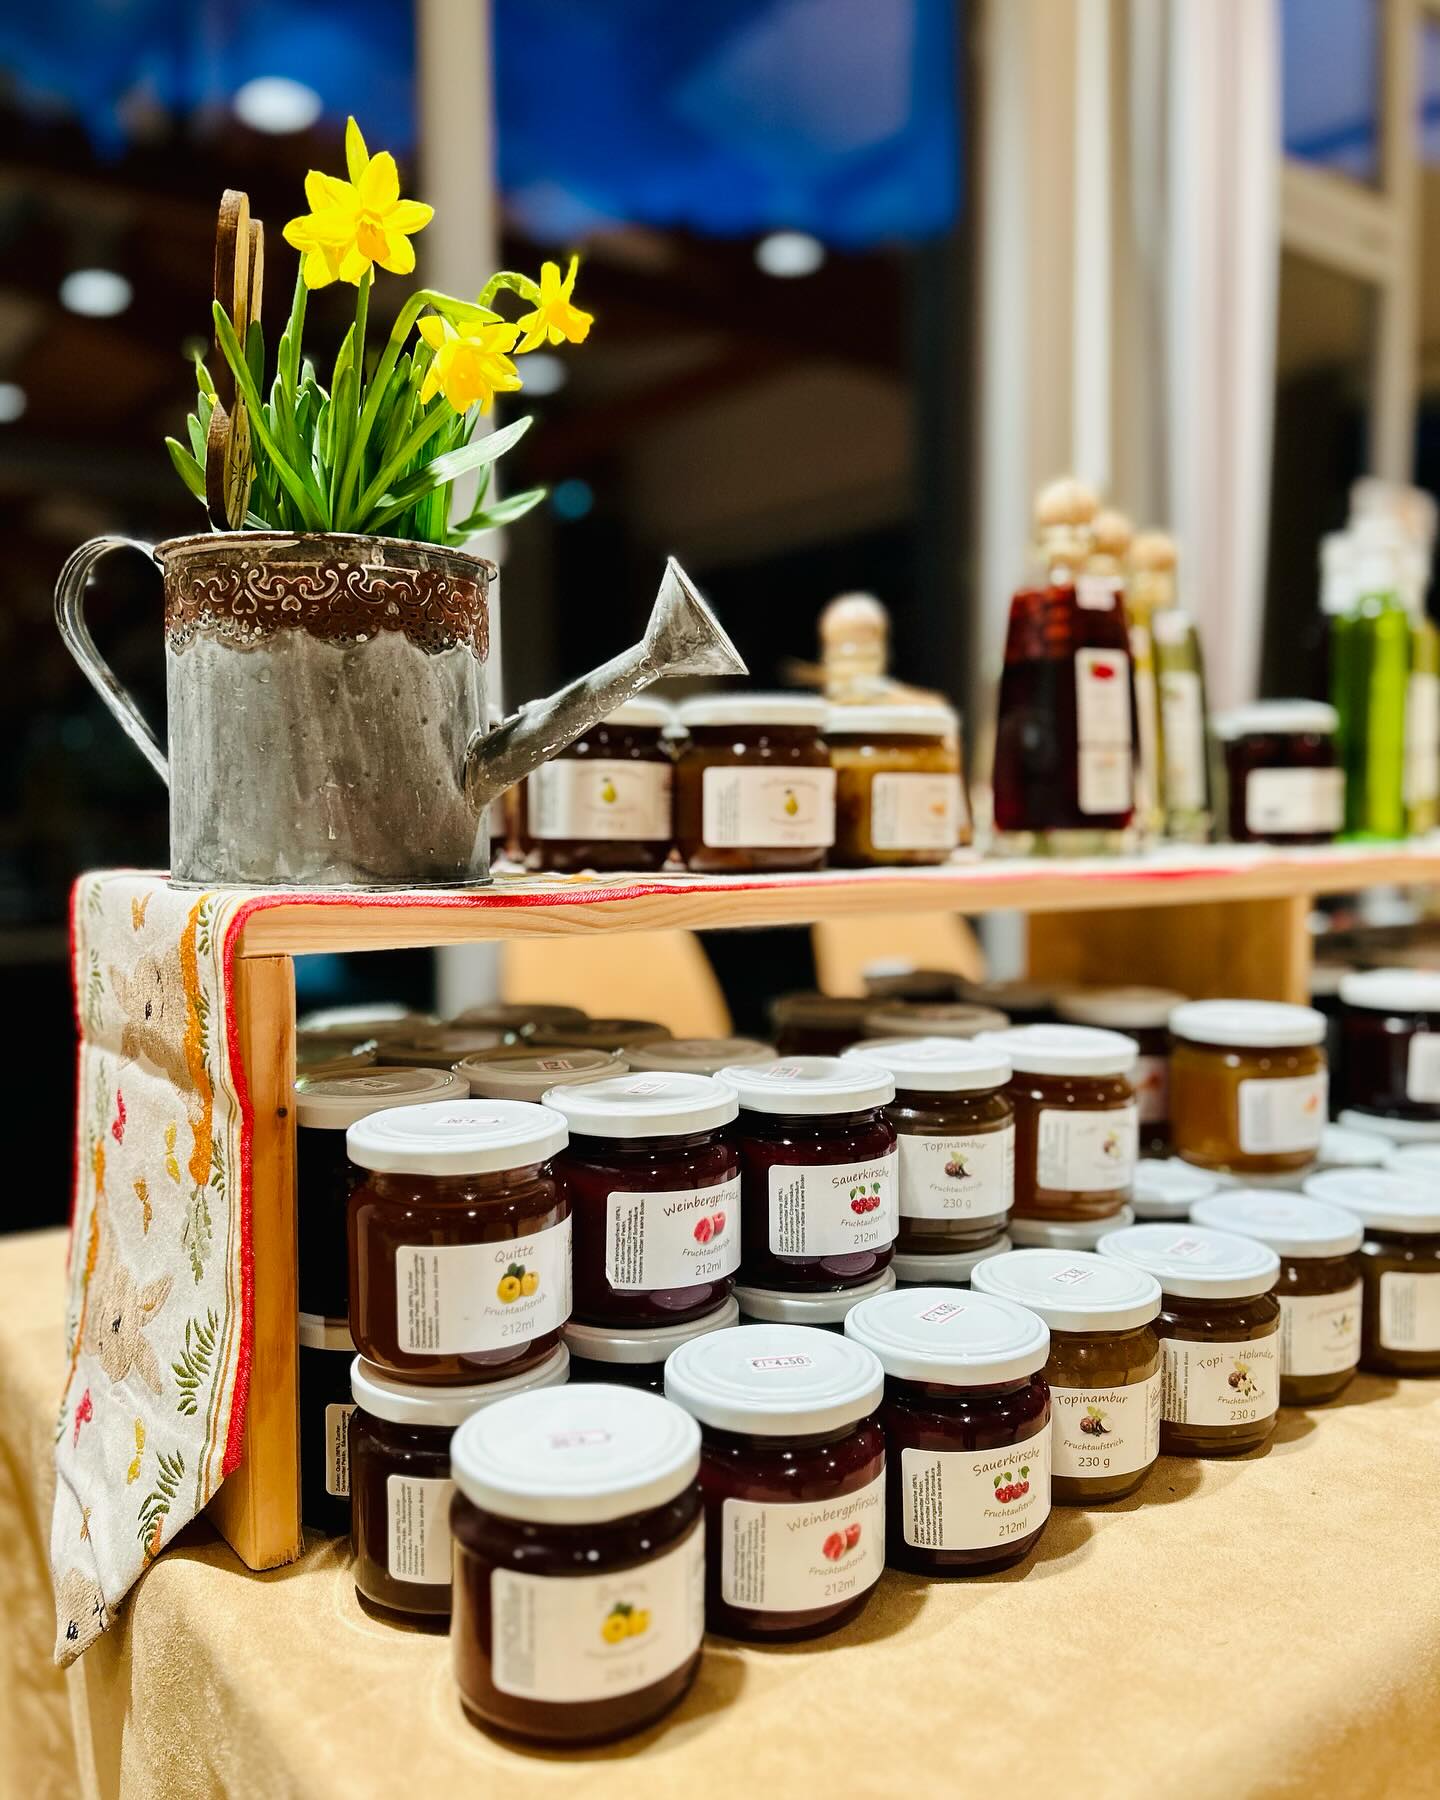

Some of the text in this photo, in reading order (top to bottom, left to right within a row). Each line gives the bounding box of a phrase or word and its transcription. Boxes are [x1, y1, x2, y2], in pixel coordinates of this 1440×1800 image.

[831, 1165, 889, 1189] Sauerkirsche
[943, 1198, 972, 1209] 230 g
[853, 1229, 880, 1245] 212ml
[494, 1245, 535, 1264] Quitte
[695, 1259, 722, 1276] 212ml
[501, 1317, 535, 1337] 212ml
[1197, 1353, 1223, 1369] Topi
[1055, 1391, 1128, 1408] Topinambur
[1230, 1409, 1256, 1421] 230 g
[1063, 1438, 1124, 1451] Fruchtaufstrich
[972, 1448, 1040, 1477] Sauerkirsche
[1078, 1456, 1110, 1468] 230 g
[998, 1517, 1027, 1537] 212ml
[824, 1576, 856, 1596] 212ml
